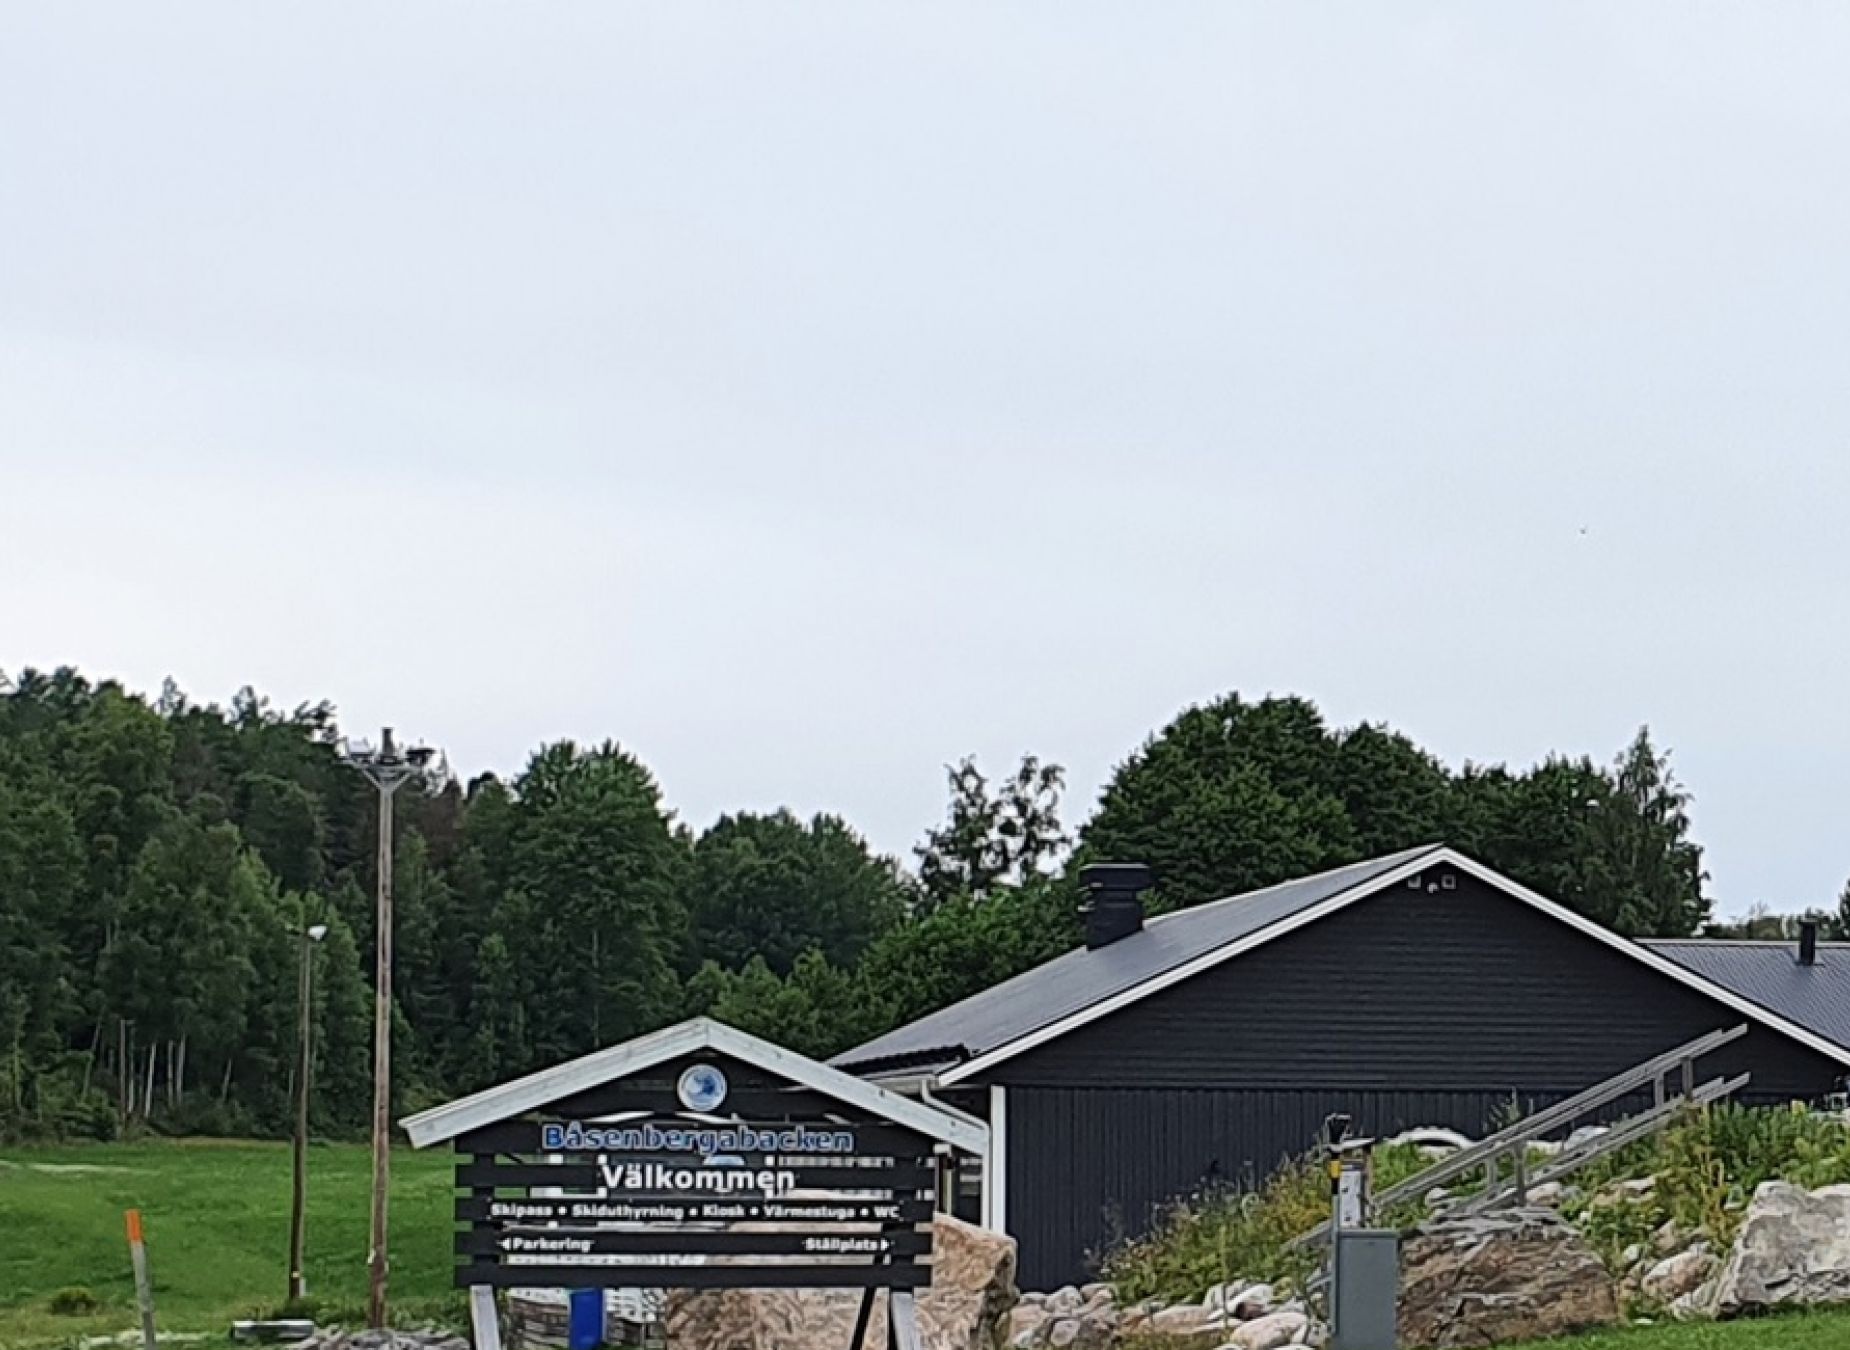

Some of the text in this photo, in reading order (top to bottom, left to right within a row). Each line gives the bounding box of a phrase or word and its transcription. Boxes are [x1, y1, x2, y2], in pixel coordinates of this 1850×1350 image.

[542, 1121, 855, 1156] Båsenbergabacken
[603, 1163, 795, 1189] Välkommen
[491, 1203, 900, 1219] Skipass Skiduthyrning Kiosk Värmestuga WC
[512, 1237, 878, 1252] Parkering Ställplats
